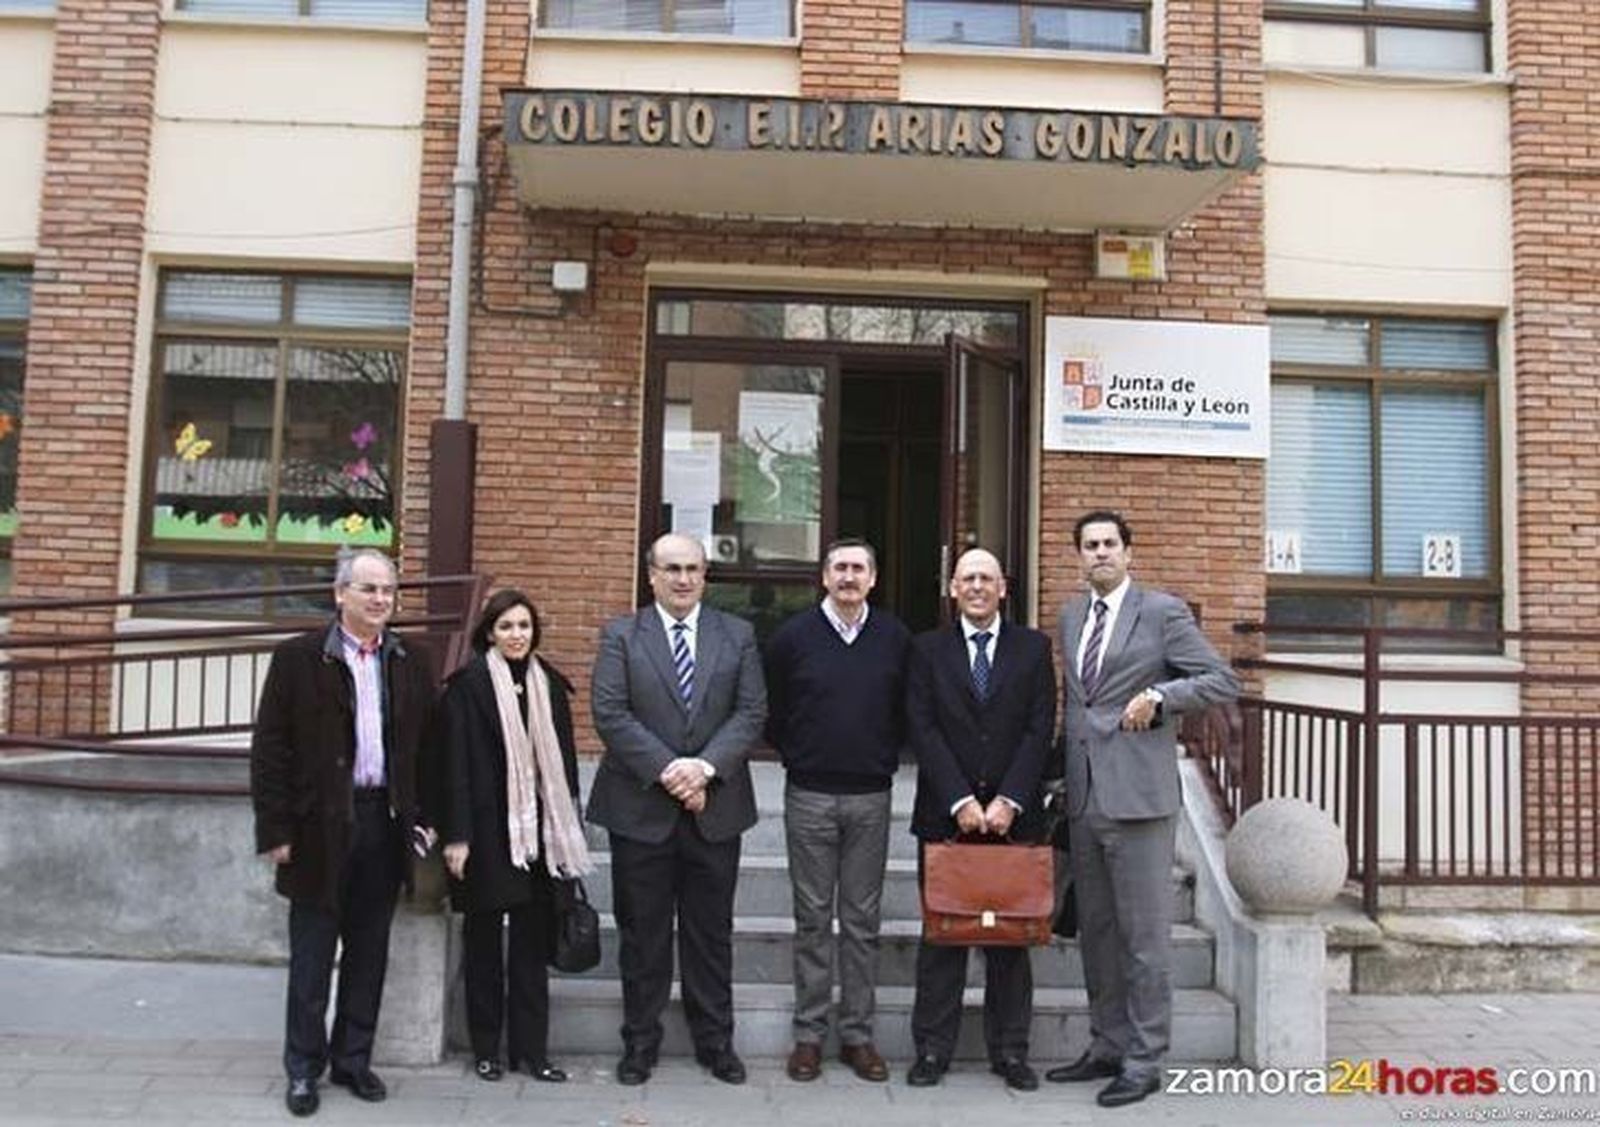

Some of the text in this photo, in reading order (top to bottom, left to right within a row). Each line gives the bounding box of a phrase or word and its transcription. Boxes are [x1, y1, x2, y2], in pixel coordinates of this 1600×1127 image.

[519, 98, 715, 147] COLEGIO
[866, 105, 1006, 156] ARIAS
[1035, 115, 1242, 166] GONZALO
[1109, 374, 1196, 393] Junta de
[1106, 393, 1250, 416] Castilla y León
